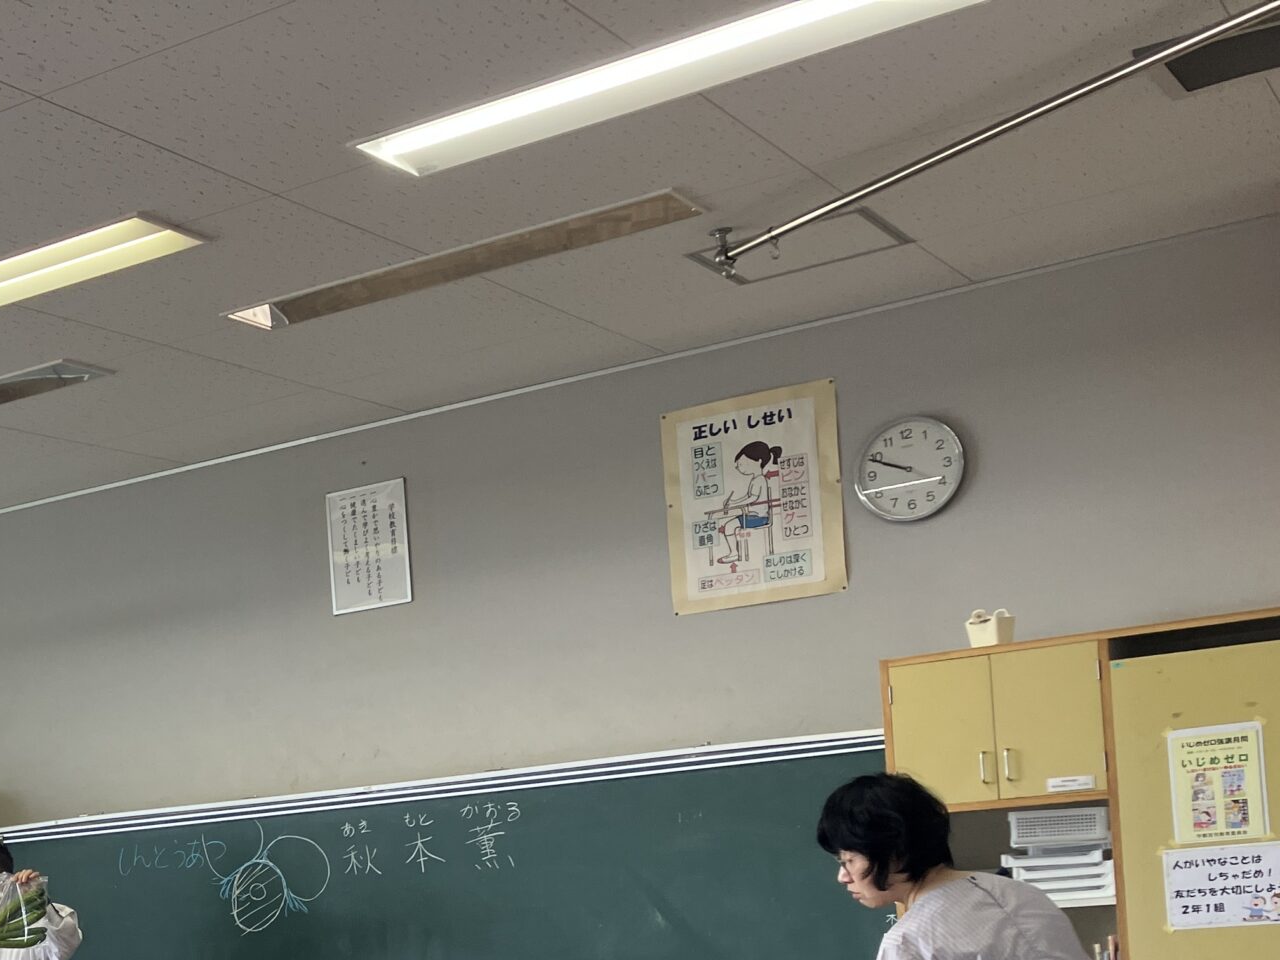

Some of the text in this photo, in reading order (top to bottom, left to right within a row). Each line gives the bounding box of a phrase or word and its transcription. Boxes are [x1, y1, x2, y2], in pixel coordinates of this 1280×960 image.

[692, 408, 792, 441] 正しい しせい
[899, 428, 912, 440] 12
[922, 430, 927, 440] 1
[883, 437, 893, 447] 11
[935, 439, 945, 450] 2
[694, 446, 716, 459] 目と
[870, 452, 883, 463] 10
[694, 459, 717, 471] つくえは
[943, 456, 952, 467] 3
[867, 470, 877, 481] 9
[938, 475, 947, 486] 4
[695, 484, 719, 497] ふたつ
[926, 491, 935, 502] 5
[890, 497, 898, 508] 7
[907, 499, 917, 510] 6
[784, 512, 808, 524] グー
[694, 521, 717, 534] ひざは
[784, 525, 809, 538] ひとつ
[769, 566, 805, 580] こしかける
[1181, 753, 1249, 768] いじめゼロ
[1172, 854, 1263, 870] 人がいやなことは
[1174, 883, 1280, 899] 友だちを大切にしよ
